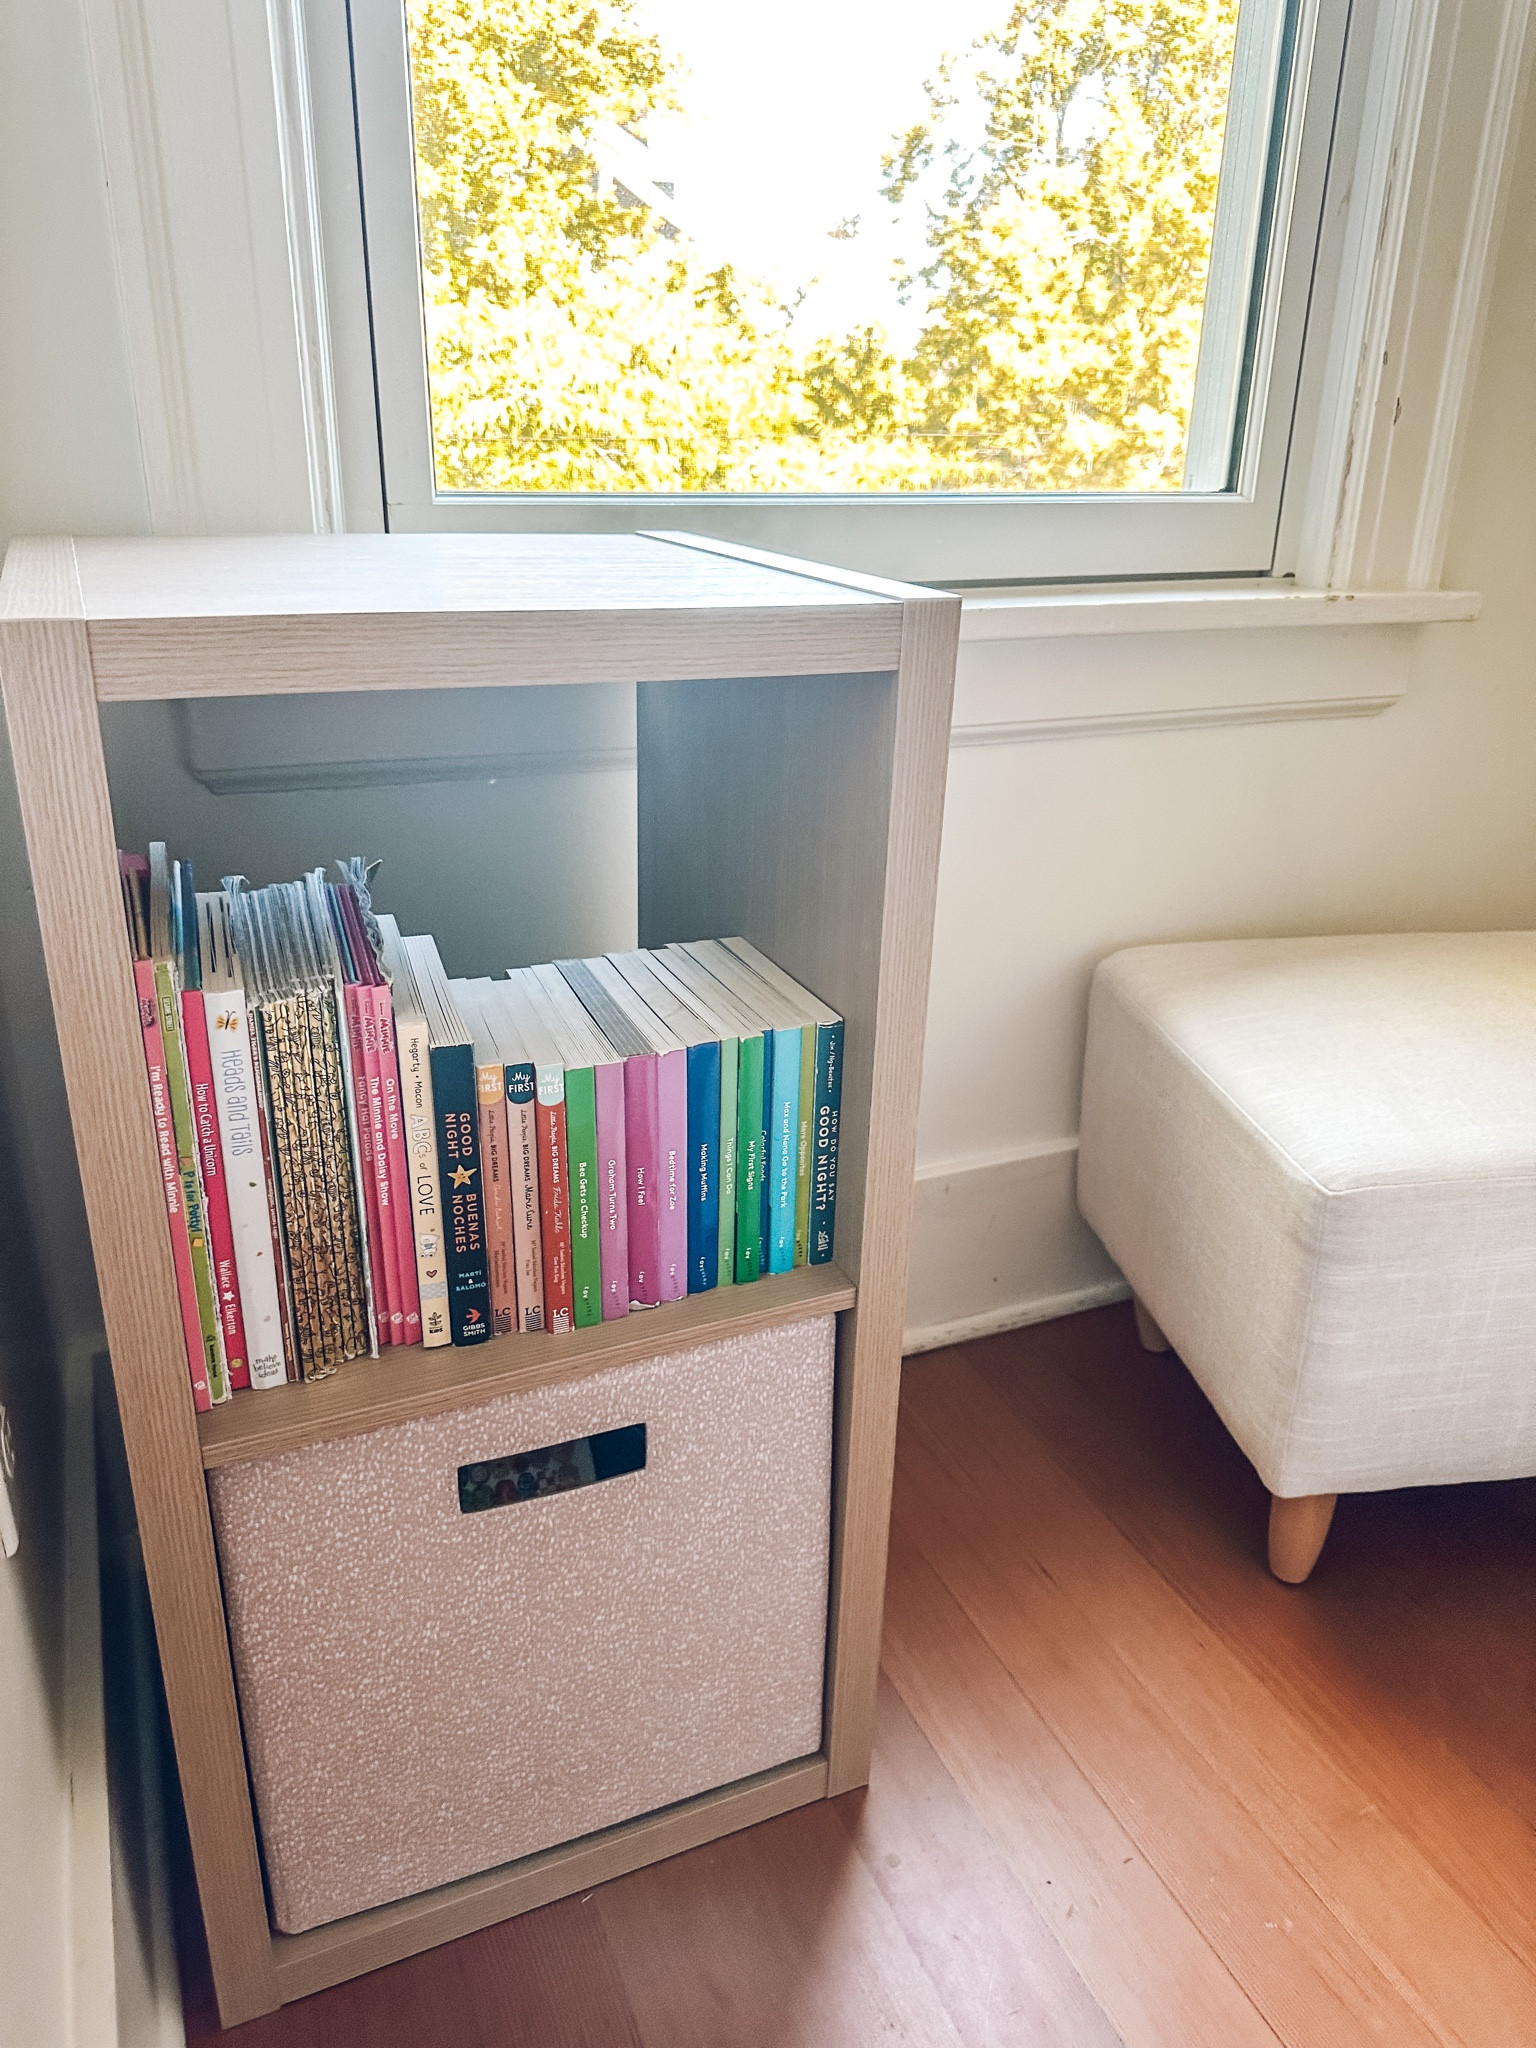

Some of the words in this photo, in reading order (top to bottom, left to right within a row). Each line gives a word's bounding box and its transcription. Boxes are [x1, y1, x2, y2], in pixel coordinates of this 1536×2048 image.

[364, 1015, 378, 1053] MINNIE
[379, 1017, 394, 1055] MINNIE
[409, 1037, 421, 1073] Hegarty
[150, 1065, 161, 1082] I'm
[221, 1050, 246, 1092] Heads
[479, 1072, 498, 1084] My
[512, 1072, 531, 1083] My
[541, 1074, 560, 1085] My
[196, 1083, 208, 1101] How
[371, 1076, 381, 1095] The
[385, 1078, 396, 1093] On
[414, 1080, 424, 1109] Macon
[508, 1082, 534, 1094] FIRST
[538, 1083, 564, 1096] FIRST
[152, 1083, 168, 1115] Ready
[199, 1103, 208, 1113] to
[227, 1096, 249, 1121] and
[387, 1095, 398, 1111] the
[372, 1097, 384, 1130] Minnie
[783, 1101, 791, 1118] Max
[158, 1118, 166, 1129] to
[200, 1114, 214, 1137] Catch
[389, 1113, 400, 1140] Move
[783, 1118, 791, 1133] and
[799, 1120, 808, 1139] More
[818, 1105, 830, 1148] GOOD
[160, 1130, 172, 1155] Read
[230, 1124, 253, 1157] Tails
[376, 1131, 386, 1152] and
[410, 1113, 433, 1159] ABCs
[460, 1112, 473, 1157] GOOD
[490, 1143, 498, 1156] BIG
[522, 1143, 530, 1155] BIG
[551, 1145, 560, 1157] BIG
[724, 1137, 734, 1162] Things
[747, 1140, 756, 1152] My
[782, 1134, 790, 1155] Nana
[830, 1139, 838, 1152] DO
[204, 1145, 219, 1177] Unicorn
[377, 1153, 389, 1179] Daisy
[418, 1162, 428, 1171] of
[668, 1150, 677, 1182] Bedtime
[699, 1143, 708, 1172] Making
[748, 1153, 756, 1170] First
[782, 1155, 789, 1167] Go
[798, 1140, 807, 1177] Opposites
[163, 1158, 176, 1180] with
[183, 1170, 196, 1178] P
[491, 1156, 500, 1183] DREAMS
[523, 1155, 531, 1182] DREAMS
[552, 1158, 560, 1184] DREAMS
[579, 1162, 588, 1177] Bea
[608, 1159, 617, 1191] Graham
[637, 1167, 645, 1185] How
[781, 1168, 788, 1177] to
[829, 1158, 837, 1178] YOU
[445, 1113, 459, 1159] NIGHT
[452, 1194, 466, 1253] NOCHES
[580, 1178, 588, 1193] Gets
[669, 1183, 677, 1196] for
[700, 1172, 709, 1201] Muffins
[725, 1184, 733, 1195] Do
[746, 1170, 756, 1191] Signs
[815, 1155, 828, 1211] NIGHT?
[166, 1181, 180, 1214] Minnie
[380, 1181, 391, 1207] Show
[417, 1174, 436, 1216] LOVE
[524, 1184, 534, 1210] Marie
[638, 1190, 646, 1206] Feel
[780, 1191, 788, 1208] Park
[828, 1184, 836, 1202] SAY
[609, 1192, 617, 1214] Turns
[669, 1196, 677, 1210] Zoe
[466, 1192, 481, 1251] BUENAS
[526, 1209, 535, 1231] Curie
[580, 1204, 589, 1239] Checkup
[609, 1214, 618, 1231] Two
[219, 1259, 232, 1288] Wallace
[455, 1281, 487, 1292] SALOMO
[225, 1303, 238, 1335] Elkerton
[495, 1307, 511, 1317] LC
[525, 1305, 541, 1316] LC
[552, 1307, 569, 1318] LC
[462, 1322, 486, 1331] GIBBS
[463, 1329, 486, 1337] SMITH
[256, 1354, 277, 1364] make
[258, 1369, 278, 1378] ideas
